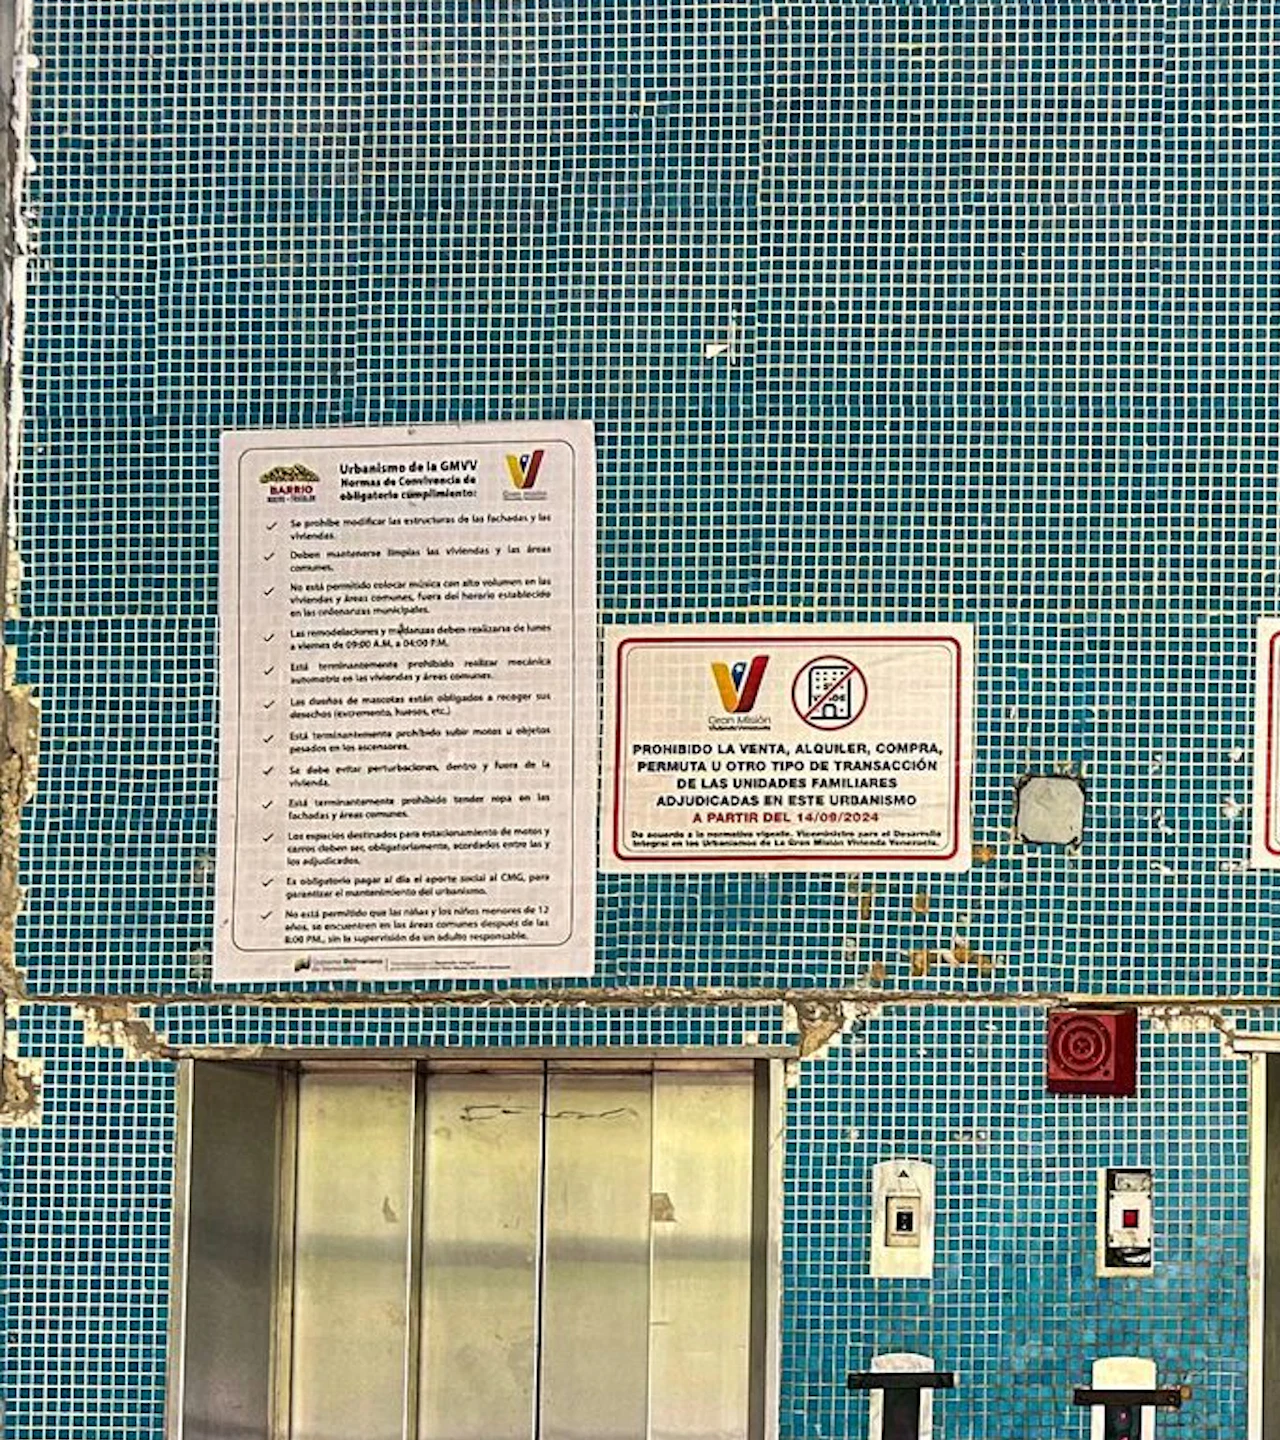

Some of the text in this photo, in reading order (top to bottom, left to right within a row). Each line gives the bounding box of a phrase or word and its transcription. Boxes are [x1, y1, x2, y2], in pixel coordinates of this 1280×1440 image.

[340, 460, 477, 474] Urbanismo de la GMVV
[342, 475, 476, 487] Normas de Convivencia de
[270, 485, 313, 495] BARRIO
[340, 489, 476, 502] obligatorio cumplimiento:
[633, 743, 942, 756] PROHIBIDO LA VENTA, ALQUILER, COMPRA,
[638, 758, 937, 772] PERMUTA U OTRO TIPO DE TRANSACCIÓN
[677, 778, 897, 789] DE LAS UNIDADES FAMILIARES
[657, 796, 916, 806] ADJUDICADAS EN ESTE URBANISMO
[693, 812, 878, 823] A PARTIR DEL 14/09/2024
